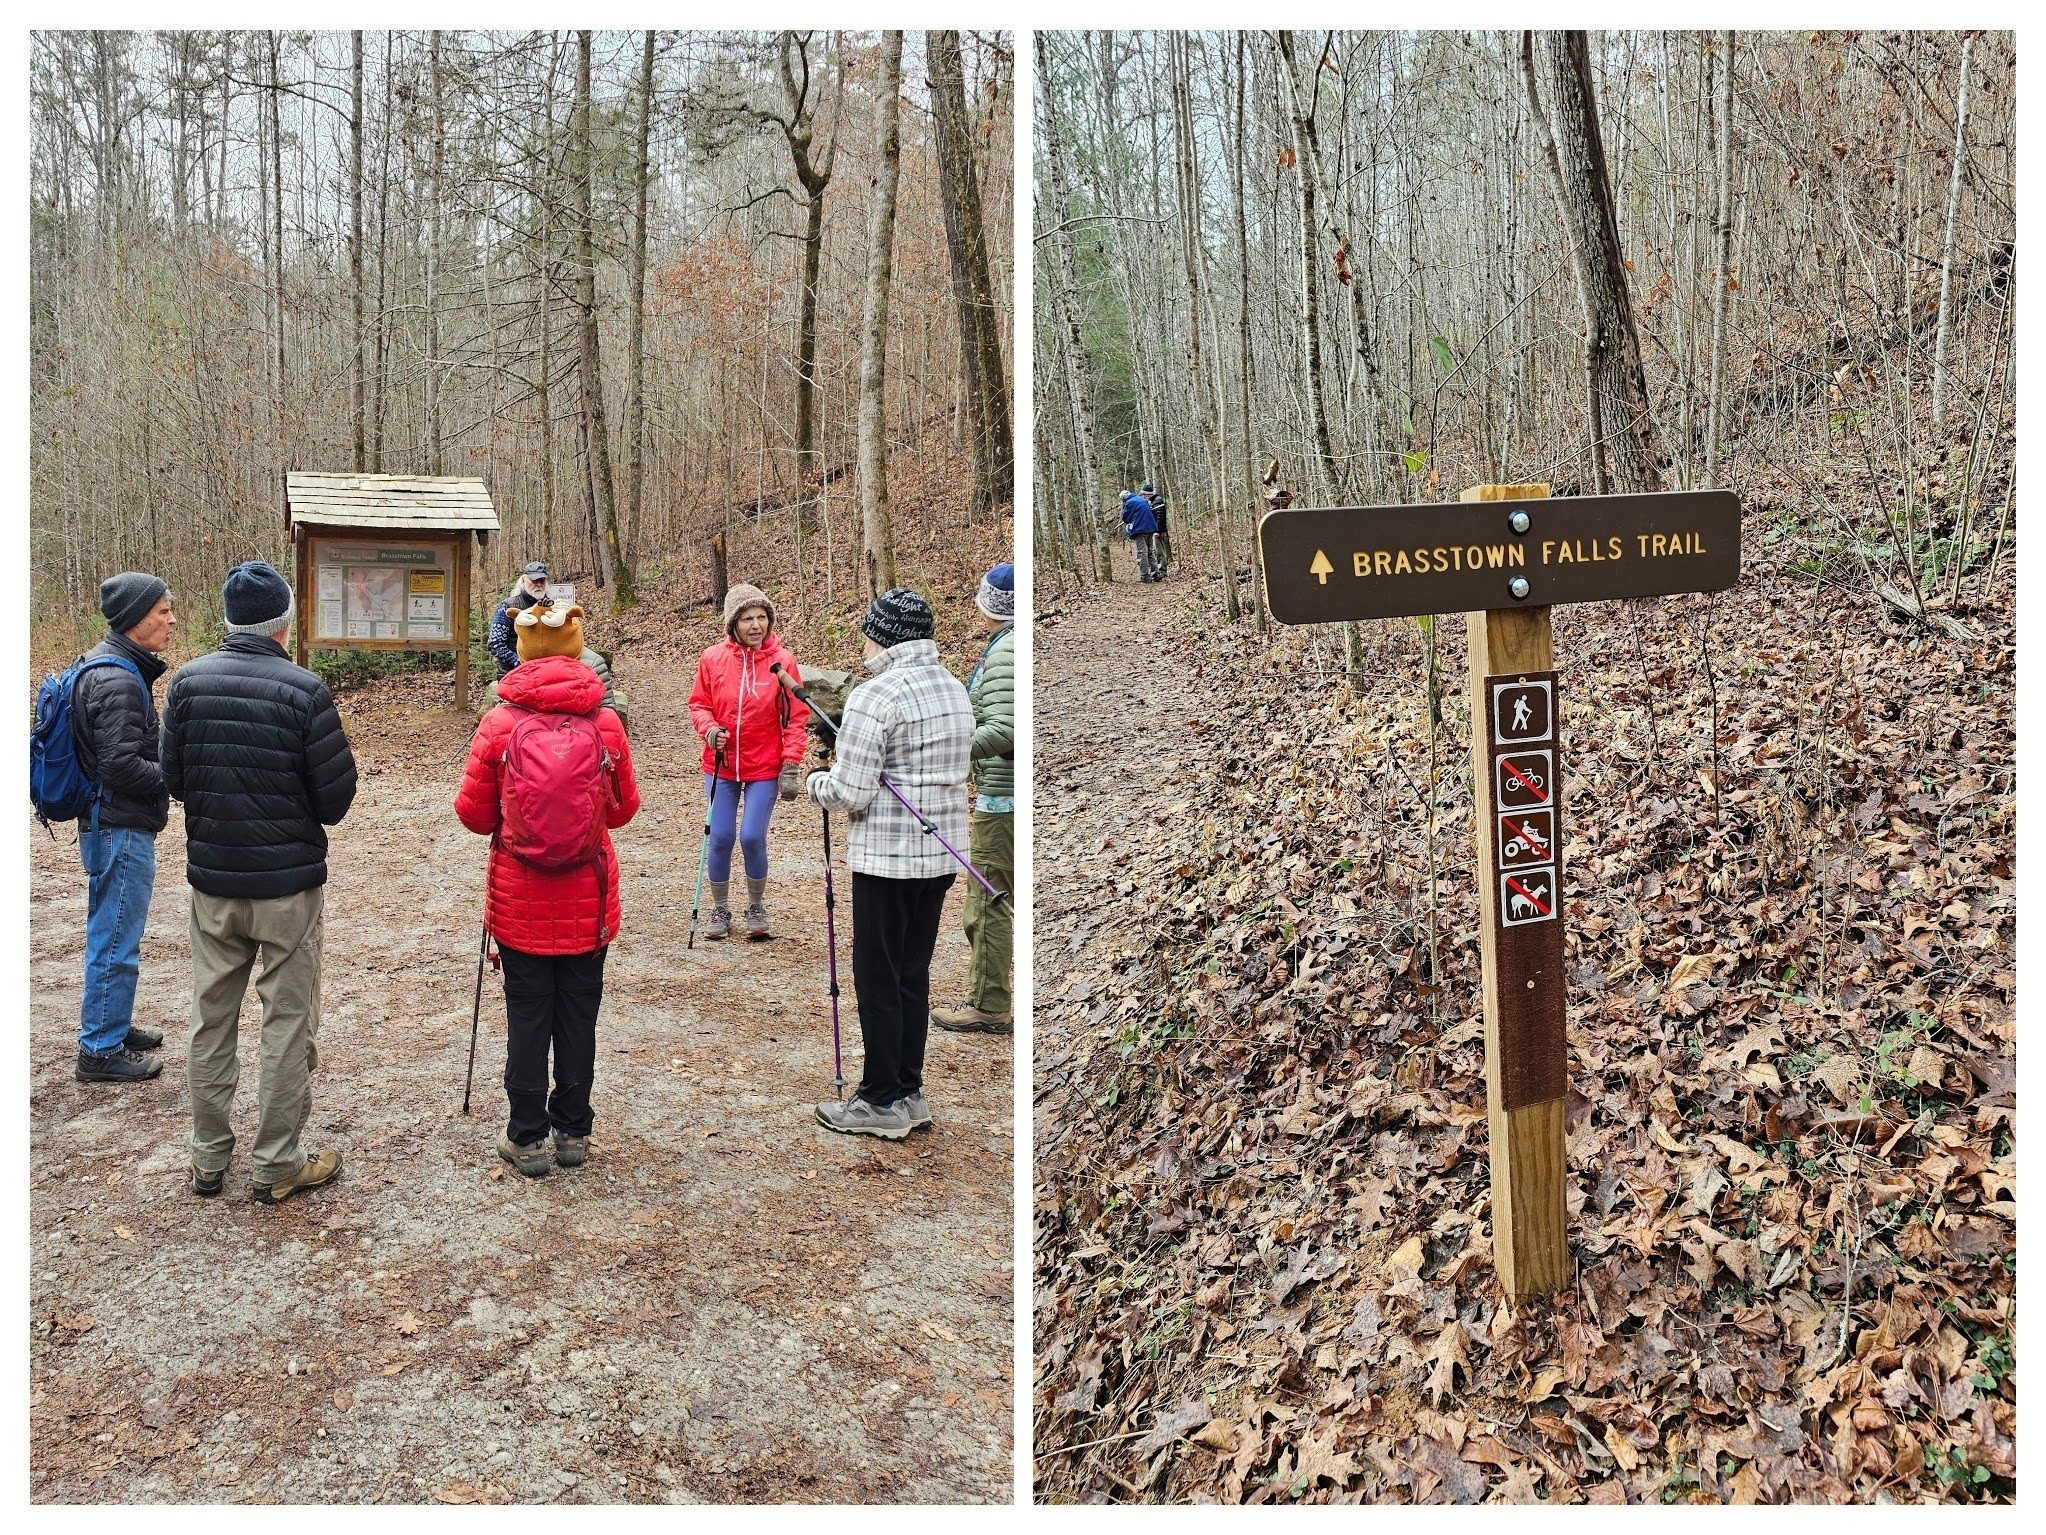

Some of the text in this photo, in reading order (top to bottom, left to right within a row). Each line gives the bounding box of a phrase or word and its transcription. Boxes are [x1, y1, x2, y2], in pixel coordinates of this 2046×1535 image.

[381, 552, 412, 560] Brasstown
[1353, 532, 1708, 577] BRASSTOWN FALLS TRAIL
